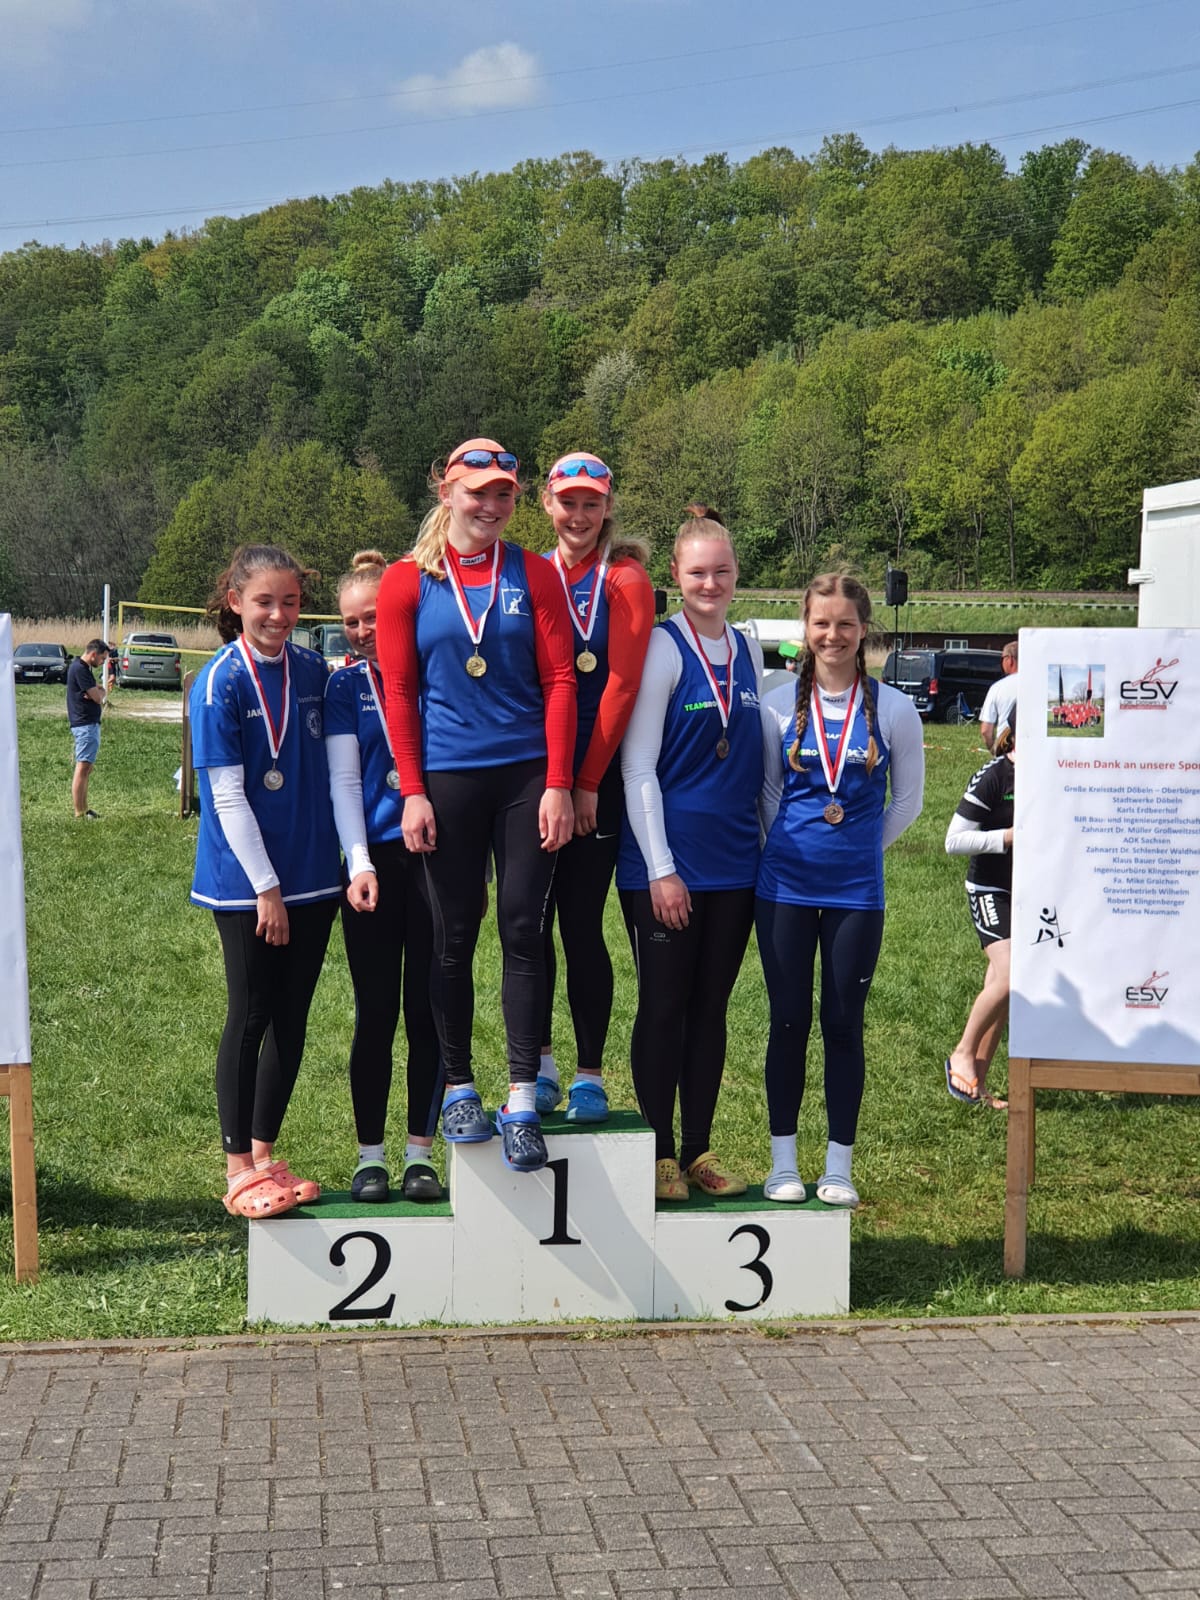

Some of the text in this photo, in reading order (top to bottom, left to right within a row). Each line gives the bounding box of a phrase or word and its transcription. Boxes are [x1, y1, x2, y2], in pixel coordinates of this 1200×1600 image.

[1120, 680, 1178, 699] ESV
[684, 701, 718, 711] TEAMBRO
[246, 708, 263, 718] JAK
[1057, 759, 1090, 769] Vielen
[1093, 759, 1120, 769] Dank
[1124, 761, 1137, 769] an
[1139, 761, 1175, 770] unsere
[1063, 785, 1087, 793] Große
[1088, 785, 1125, 793] Kreisstadt
[1156, 796, 1183, 804] Döbeln
[1136, 806, 1178, 814] Erdbeerhof
[1081, 825, 1114, 833] Zahnarzt
[1127, 825, 1152, 834] Müller
[1123, 836, 1171, 844] AOK Sachsen
[1086, 845, 1118, 853] Zahnarzt
[1120, 846, 1130, 854] Dr.
[1132, 846, 1168, 854] Schlenker
[1112, 856, 1132, 864] Klaus
[1157, 857, 1181, 865] GmbH
[1094, 866, 1199, 876] Ingenieurbüro Klingenberger
[1146, 877, 1179, 885] Graichen
[1103, 886, 1190, 895] Gravierbetrieb Wilhelm
[1107, 897, 1185, 907] Robert Klingenberger
[983, 893, 1000, 926] KANU
[1143, 908, 1180, 916] Naumann
[1125, 986, 1169, 1002] ESV
[539, 1158, 582, 1245] 1
[724, 1223, 774, 1312] 3
[328, 1230, 396, 1321] 2
